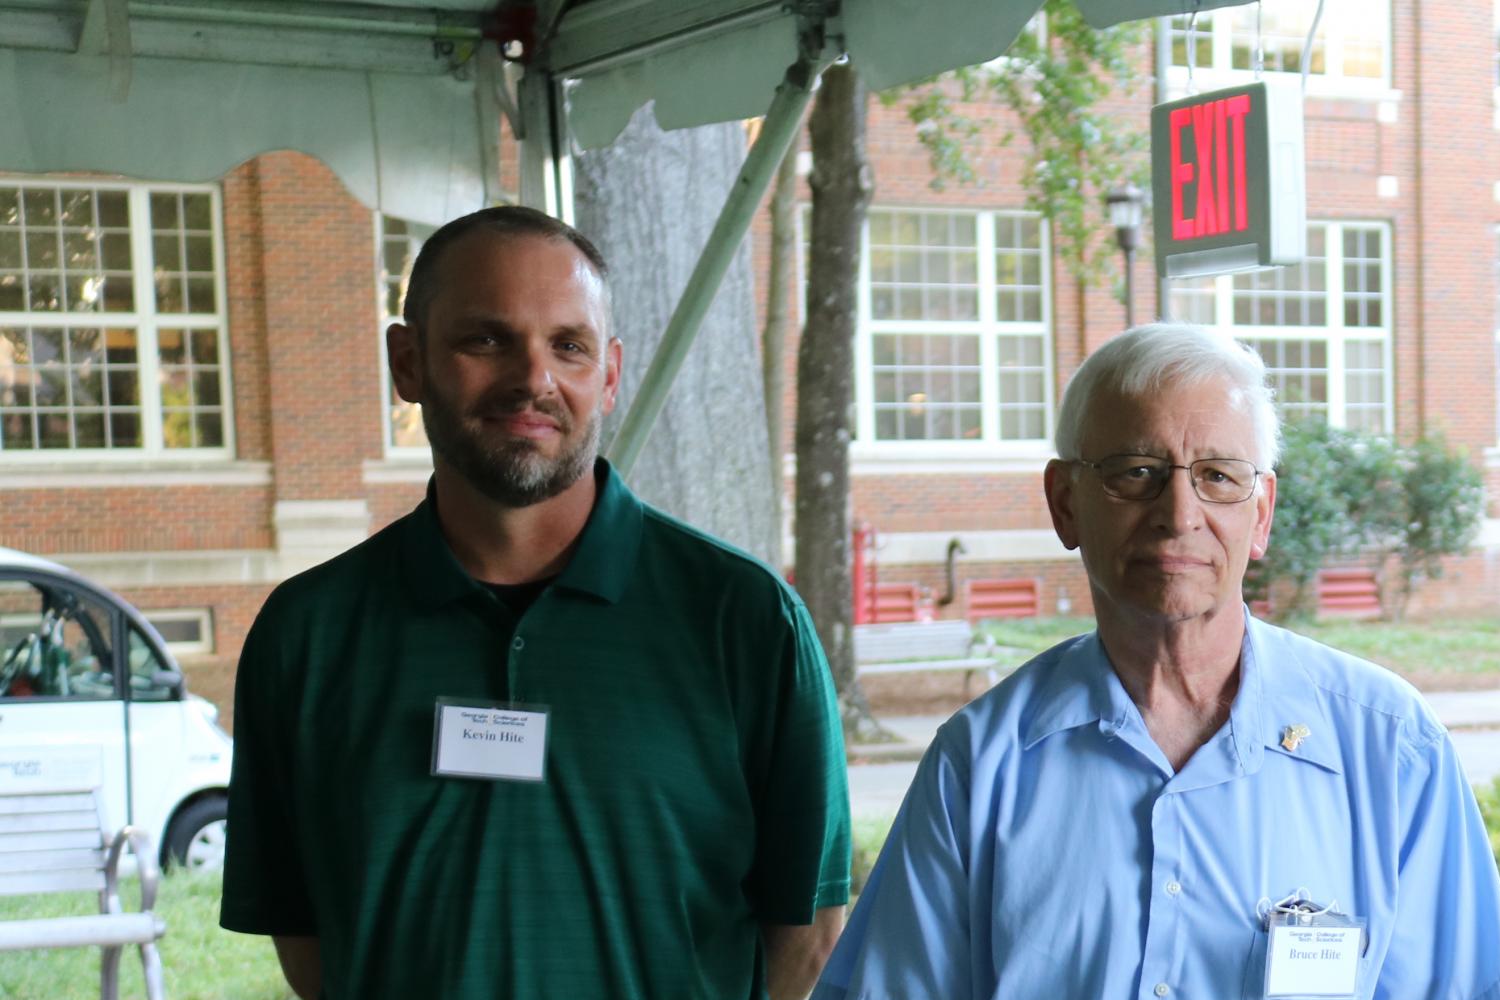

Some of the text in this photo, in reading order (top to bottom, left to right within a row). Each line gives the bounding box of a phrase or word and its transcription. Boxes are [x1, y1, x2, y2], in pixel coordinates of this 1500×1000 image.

[1170, 94, 1251, 240] EXIT
[463, 728, 525, 743] Kevin Hite
[1289, 948, 1341, 960] Bruce Hite
